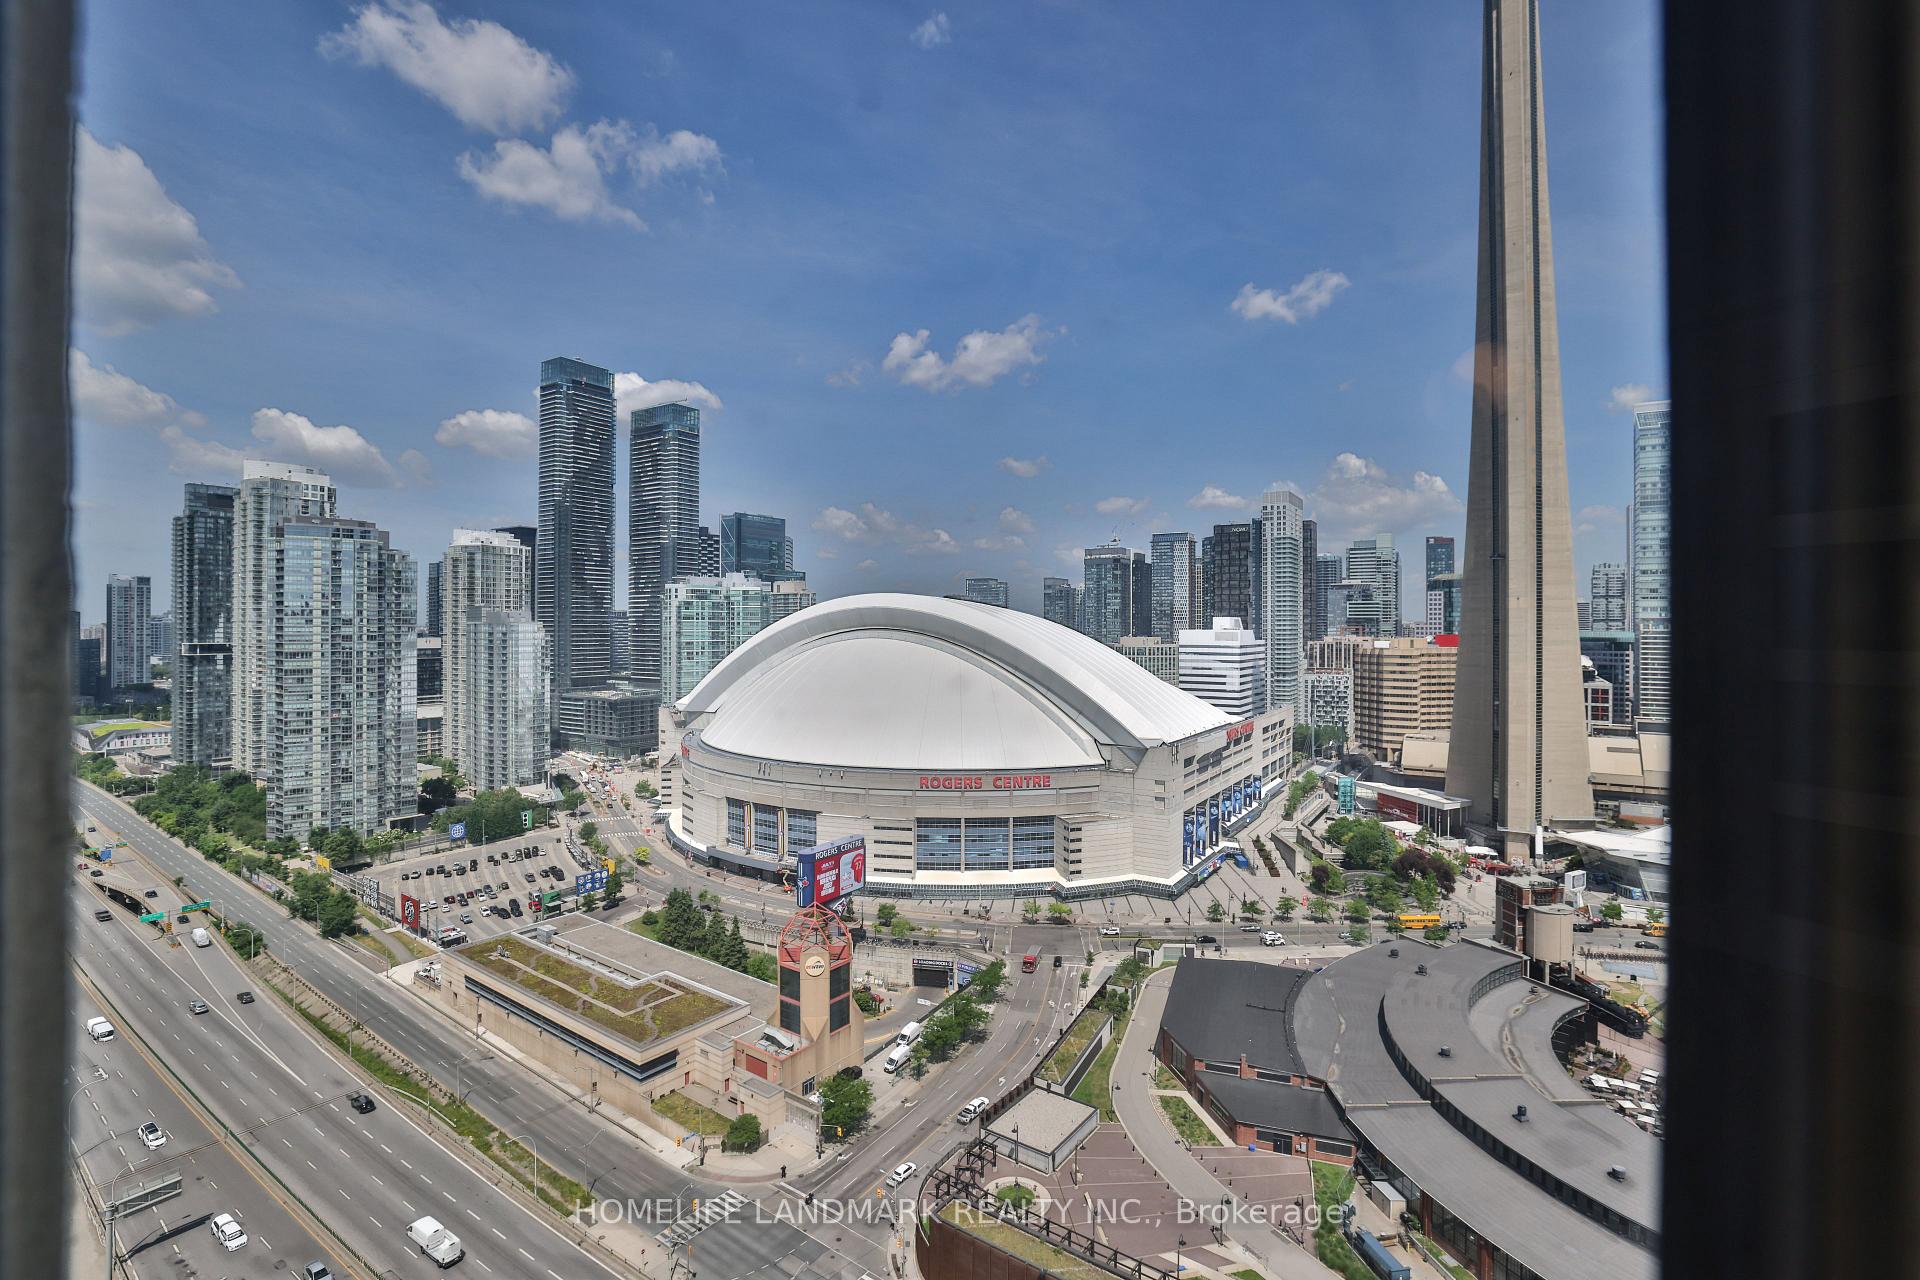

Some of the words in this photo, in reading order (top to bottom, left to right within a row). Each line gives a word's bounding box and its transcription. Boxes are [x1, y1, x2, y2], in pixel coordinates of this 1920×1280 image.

[919, 776, 982, 790] ROGERS
[992, 775, 1051, 789] CENTRE
[816, 847, 838, 860] ROGERS
[840, 840, 862, 852] CENTRE
